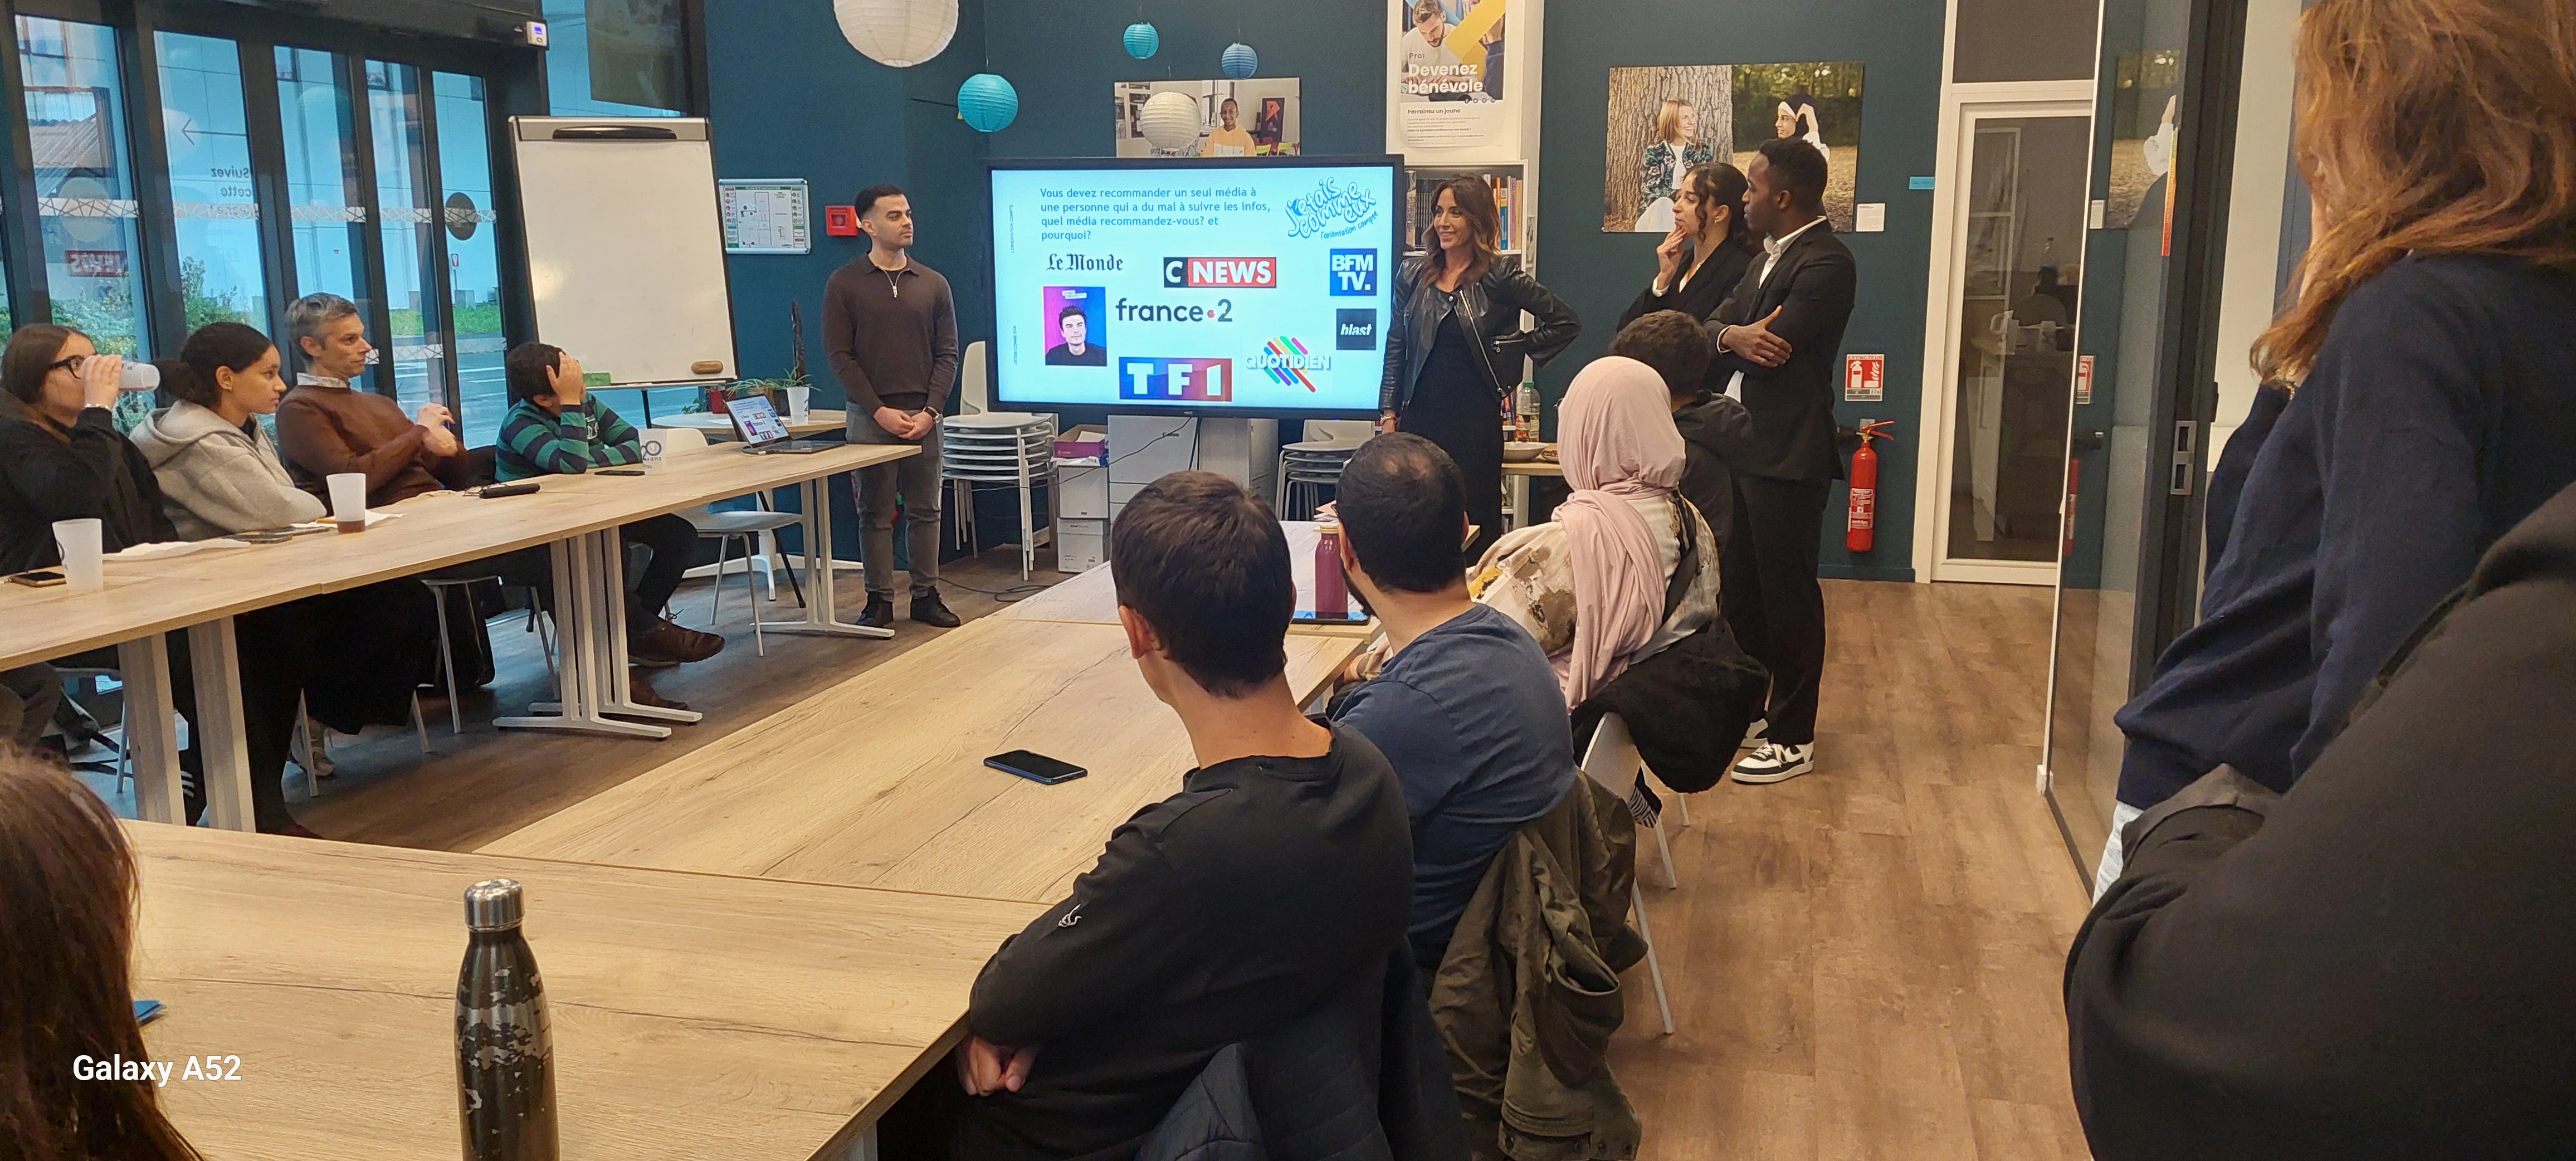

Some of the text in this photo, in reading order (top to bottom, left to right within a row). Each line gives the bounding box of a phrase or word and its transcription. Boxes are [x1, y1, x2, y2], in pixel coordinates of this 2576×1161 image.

[1409, 64, 1477, 76] Devenez
[1408, 79, 1484, 94] bénévole
[1040, 188, 1063, 198] Vous
[1066, 188, 1097, 198] devez
[1100, 188, 1171, 198] recommander
[1191, 187, 1212, 197] seul
[1215, 187, 1247, 197] média
[1251, 187, 1257, 197] à
[1063, 204, 1110, 214] personne
[1113, 202, 1129, 214] qui
[1141, 202, 1154, 212] du
[1158, 202, 1176, 212] mal
[1179, 202, 1185, 211] à
[1188, 202, 1220, 212] suivre
[1224, 202, 1238, 211] les
[1242, 202, 1270, 213] infos,
[1344, 188, 1376, 223] eux
[1041, 216, 1219, 227] quel média recommandez-vous? et
[1042, 230, 1091, 242] pourquoi?
[1046, 253, 1124, 271] Le Monde
[1332, 255, 1373, 271] BFM
[1115, 297, 1232, 322] france 2
[1340, 324, 1372, 335] blast
[1246, 354, 1331, 370] QUOTIDIEN
[1127, 363, 1221, 396] TF1
